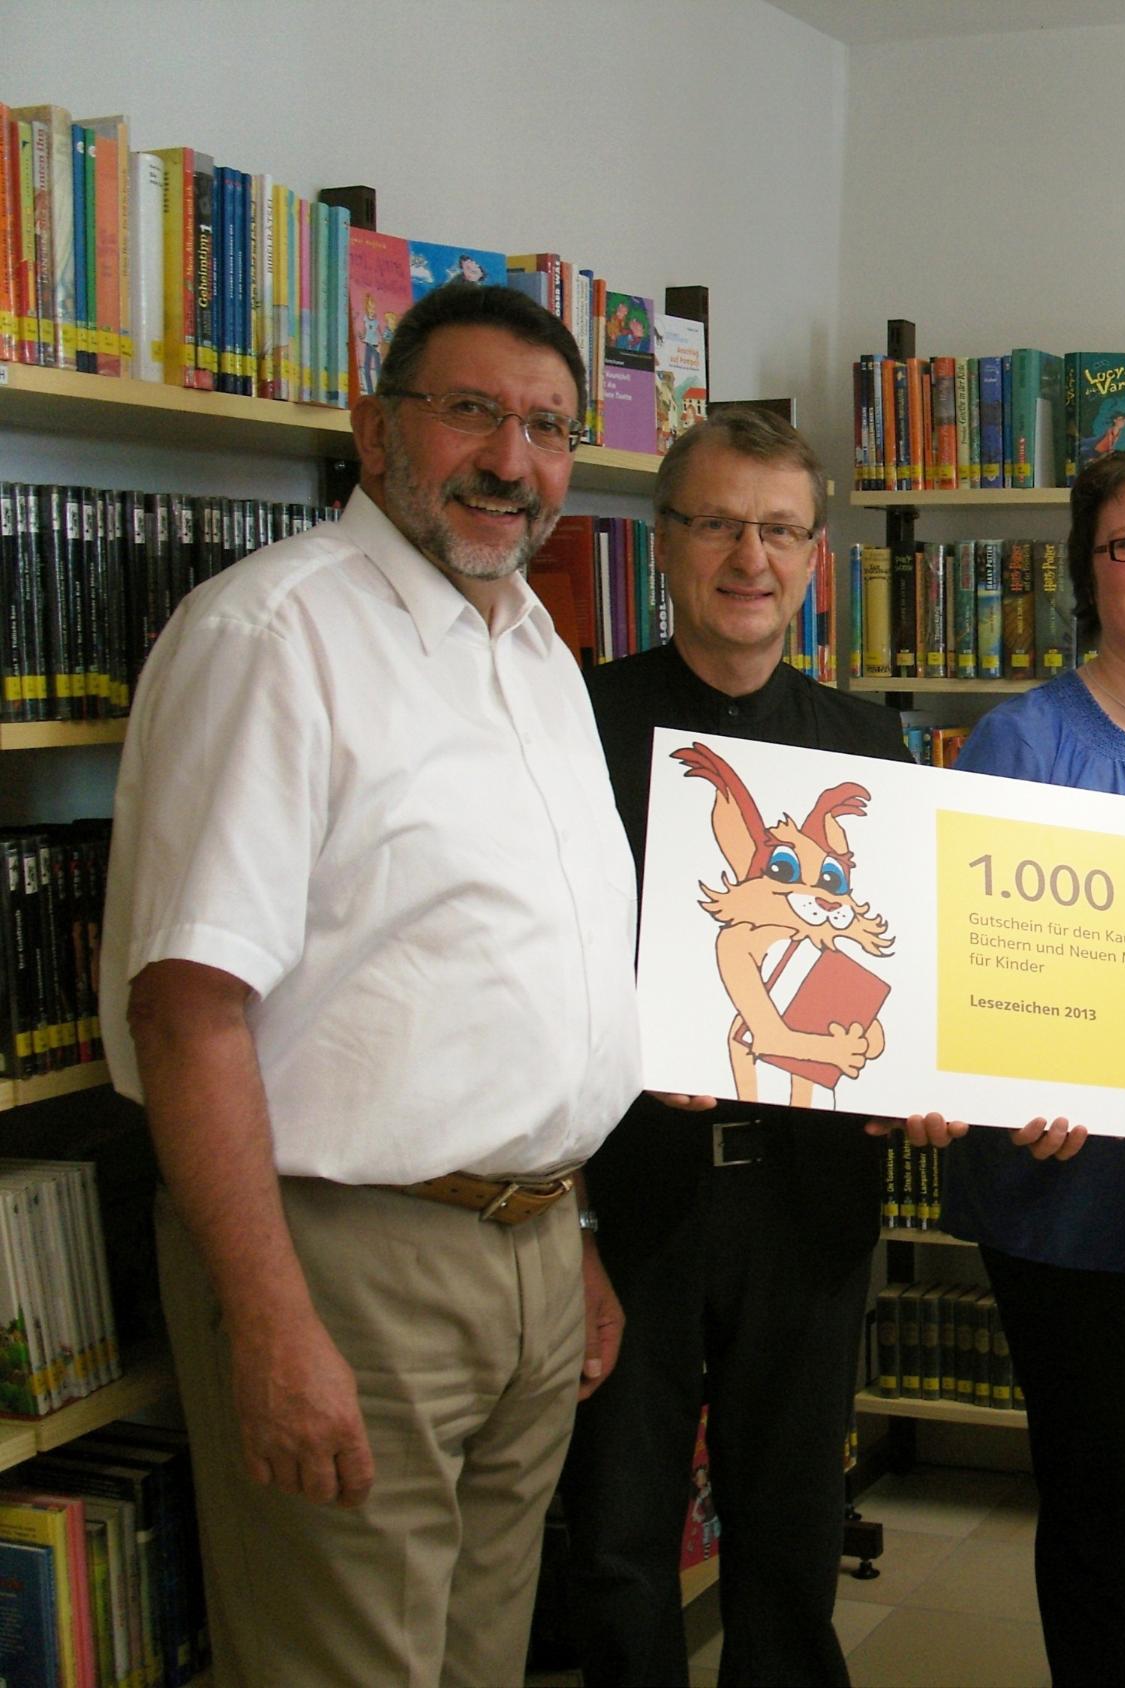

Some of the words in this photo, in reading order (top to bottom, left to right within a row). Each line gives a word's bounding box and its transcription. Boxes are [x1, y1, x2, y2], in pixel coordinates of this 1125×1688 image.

[198, 234, 209, 308] Geheimtipp
[1085, 366, 1125, 384] Lucy
[1041, 544, 1057, 569] Potter
[1043, 569, 1057, 593] Harry
[968, 854, 1114, 911] 1.000
[969, 912, 1043, 933] Gutschein
[1047, 922, 1069, 936] für
[1073, 926, 1101, 941] den
[969, 932, 1032, 951] Büchern
[1036, 941, 1064, 956] und
[1070, 945, 1117, 962] Neuen
[969, 952, 991, 967] für
[995, 956, 1045, 973] Kinder
[970, 994, 1060, 1017] Lesezeichen
[1064, 1006, 1097, 1021] 2013
